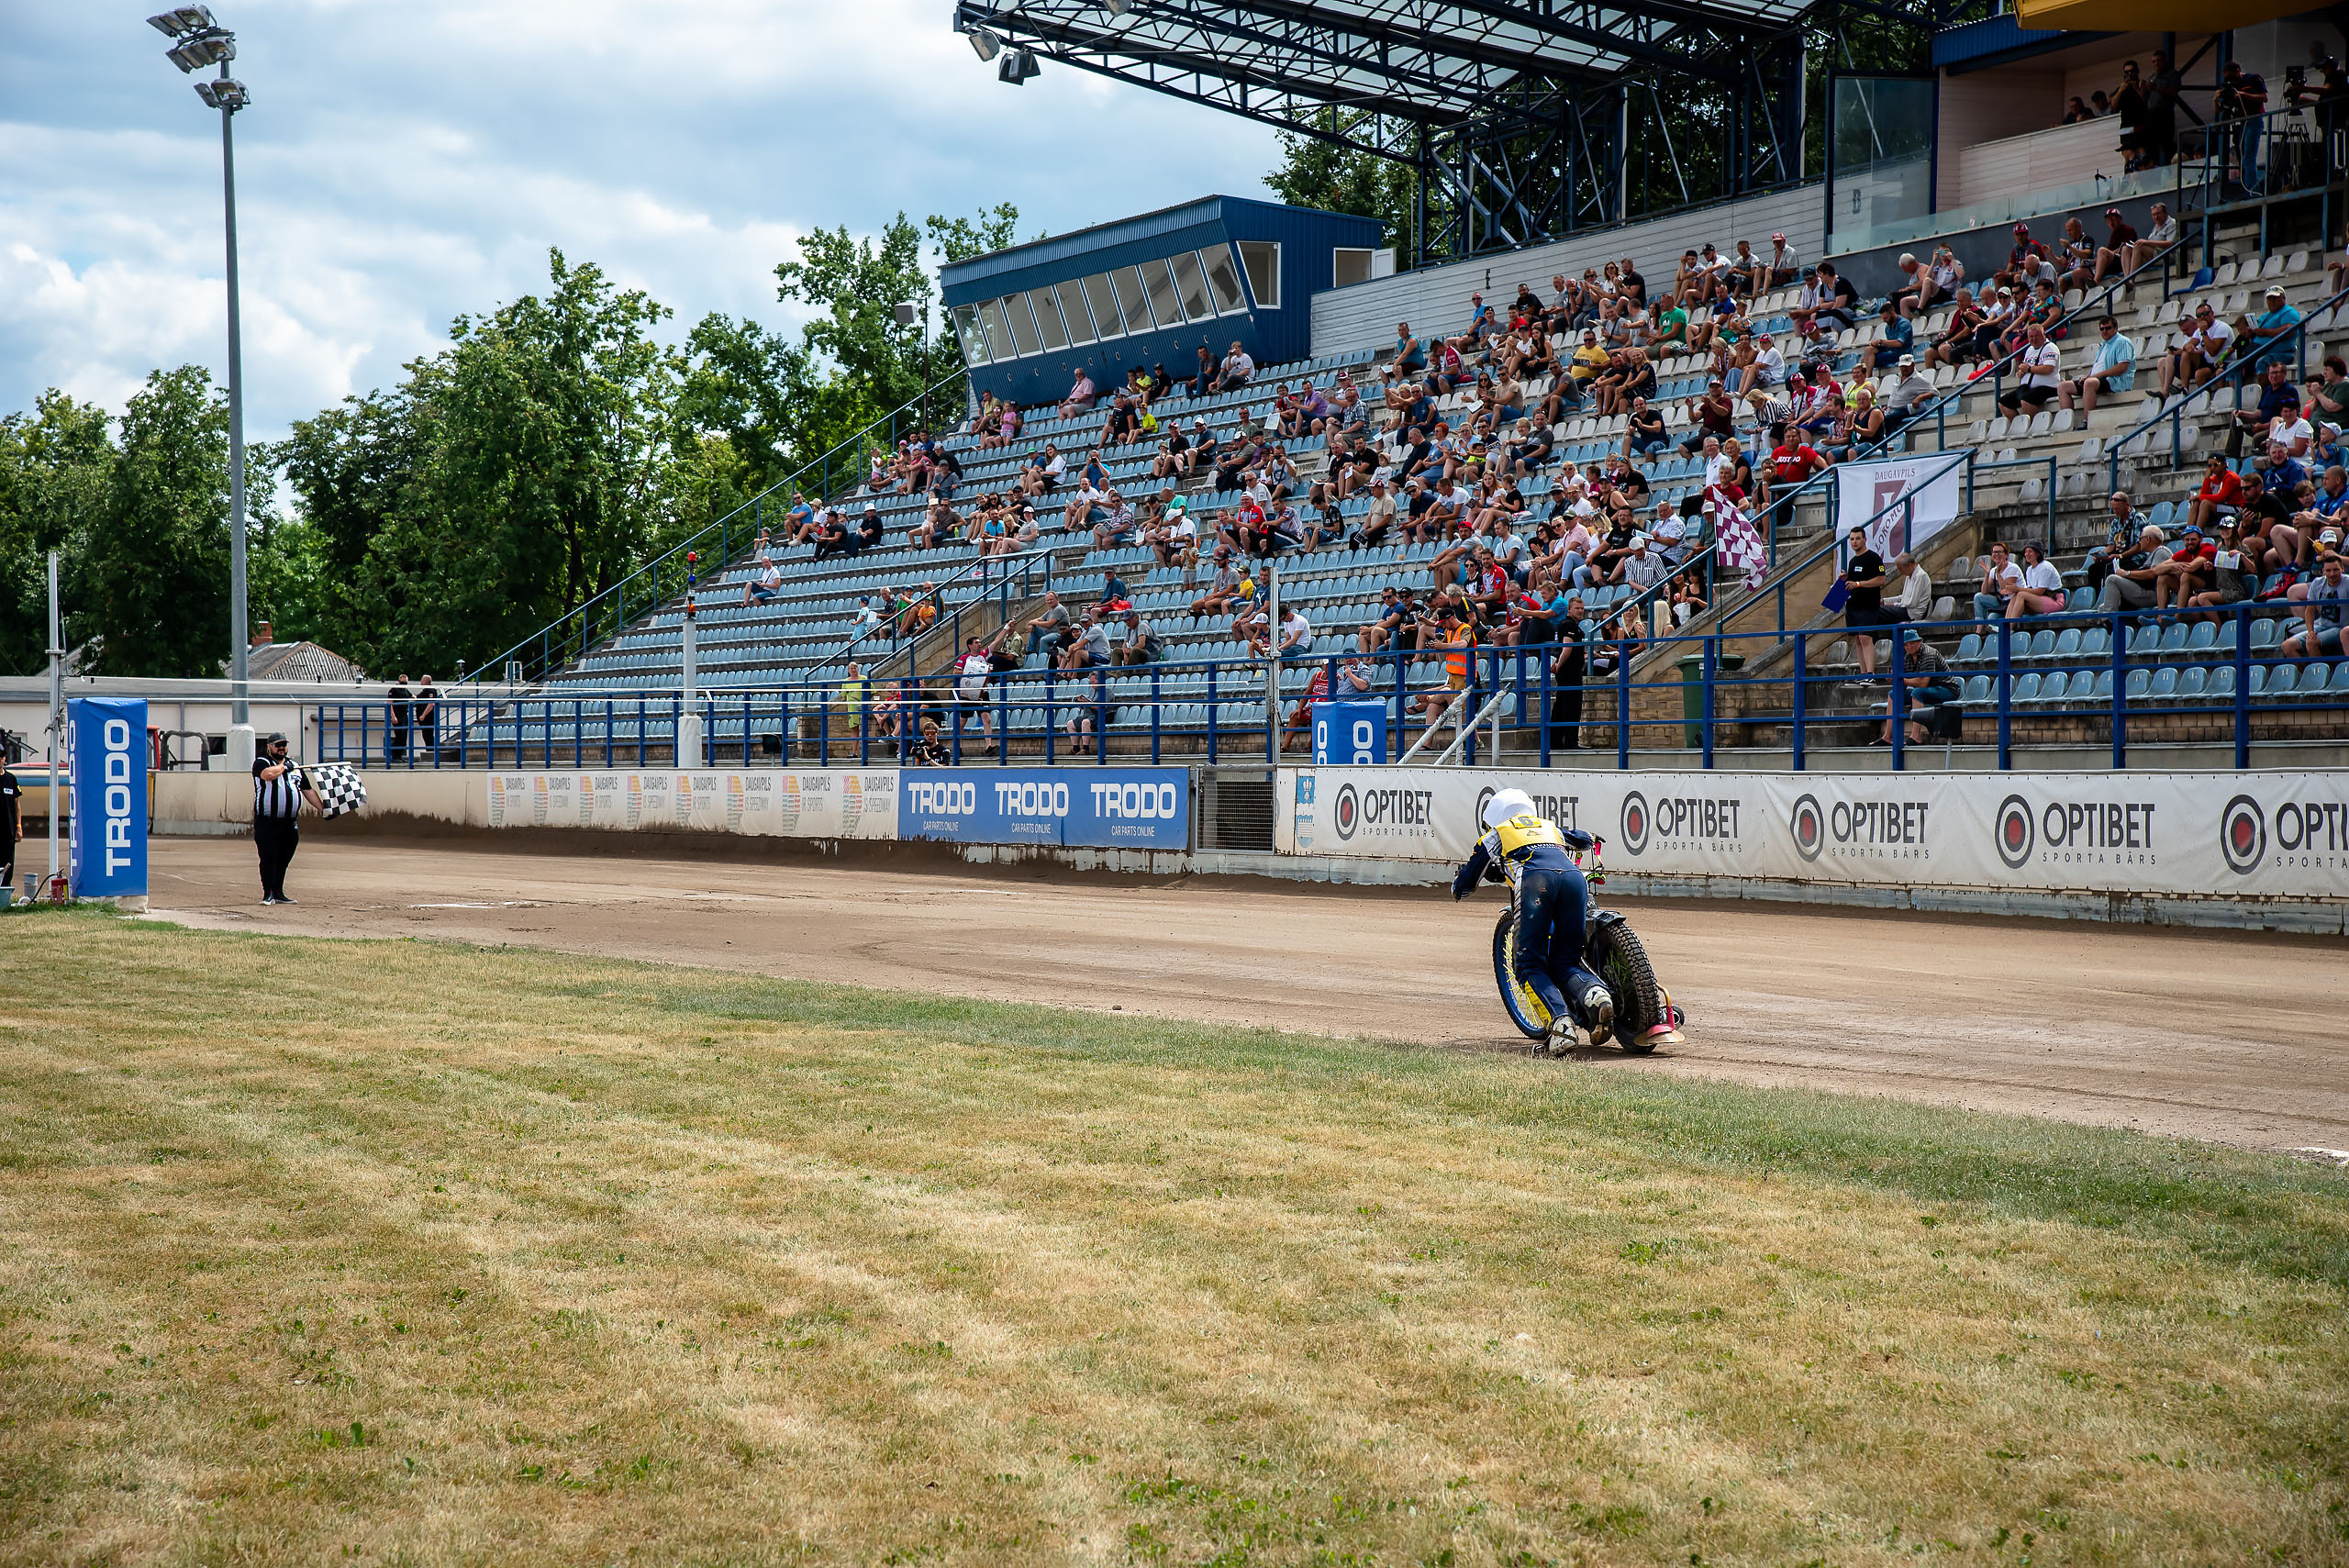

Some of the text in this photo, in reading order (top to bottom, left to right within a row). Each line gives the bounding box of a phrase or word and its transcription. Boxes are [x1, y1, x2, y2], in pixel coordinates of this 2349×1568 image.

[1776, 455, 1792, 463] JUST
[1875, 468, 1916, 481] DAUGAVPILS
[1875, 483, 1913, 551] LOKOMOV
[506, 776, 526, 791] DAUGAVPILS
[549, 777, 571, 791] DAUGAVPILS
[595, 776, 618, 791] DAUGAVPILS
[643, 776, 668, 791] DAUGAVPILS
[693, 776, 717, 792] DAUGAVPILS
[745, 776, 772, 792] DAUGAVPILS
[802, 776, 831, 792] DAUGAVPILS
[864, 776, 895, 792] DAUGAVPILS
[104, 718, 131, 877] TRODO
[648, 795, 666, 809] SPEEDWAY
[697, 796, 711, 811] SPORTS
[750, 796, 770, 812] SPEEDWAY
[802, 797, 823, 812] IR SPORTS
[863, 797, 891, 813] IS SPEEDWAY
[907, 782, 976, 815] TRODO
[995, 783, 1069, 817] TRODO
[1090, 783, 1176, 818] TRODO
[1364, 789, 1432, 826] OPTIBET
[1529, 795, 1578, 830] TIBET
[923, 820, 959, 831] CAR PARTS ONLINE
[1518, 816, 1533, 826] 6
[1655, 797, 1741, 840] OPTIBET
[1831, 801, 1929, 844] OPTIBET
[2043, 802, 2155, 849] OPTIBET
[1011, 822, 1052, 834] CAR PARTS ONLINE
[1111, 825, 1155, 837] CAR PARTS ONLINE
[1363, 826, 1435, 838] SPORTA BĀRS
[1655, 840, 1742, 853] SPORTA BĀRS
[1831, 845, 1930, 860] SPORTA BĀRS
[2043, 851, 2156, 865] SPORTA BĀRS
[2277, 856, 2348, 869] SPORTA
